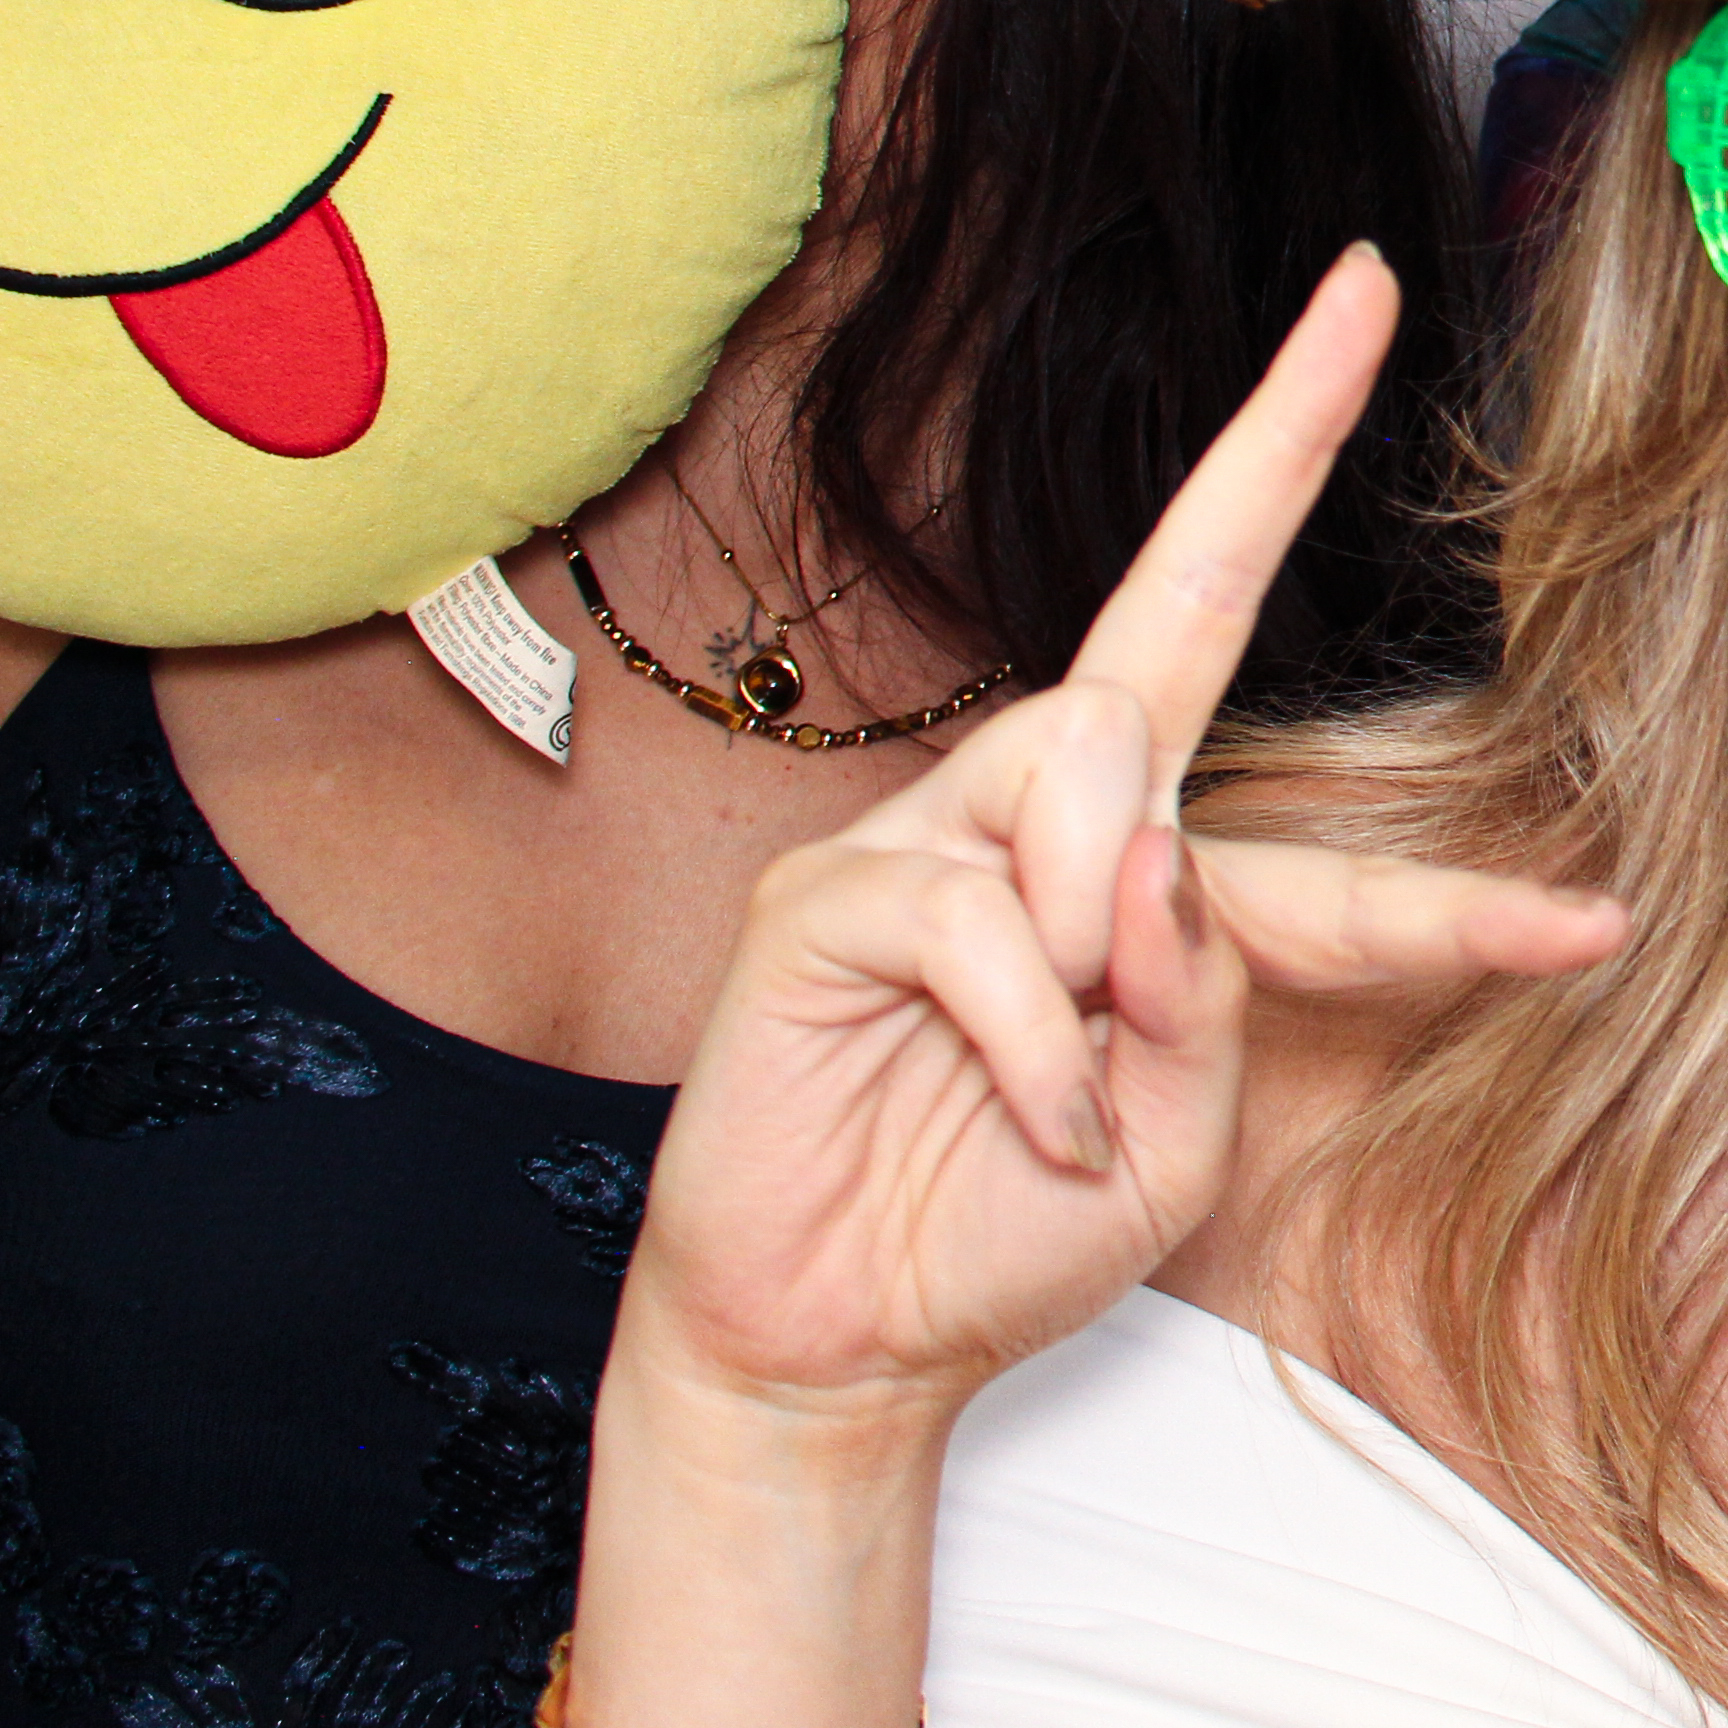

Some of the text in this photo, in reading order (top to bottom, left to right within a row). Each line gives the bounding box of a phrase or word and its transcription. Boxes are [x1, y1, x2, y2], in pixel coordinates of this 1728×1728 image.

[470, 593, 486, 614] 100%
[482, 610, 511, 646] Polyester
[472, 563, 556, 665] WARNING! Keep away from fire
[459, 601, 482, 634] Polyester
[480, 631, 496, 652] fibre
[499, 652, 522, 676] Made
[519, 672, 530, 683] in
[529, 679, 553, 701] China
[462, 633, 477, 651] have
[474, 648, 491, 667] been
[489, 664, 510, 685] tested
[507, 683, 523, 697] and
[520, 695, 546, 715] comply
[471, 677, 507, 714] Regulations
[502, 693, 512, 701] of
[509, 698, 521, 711] the
